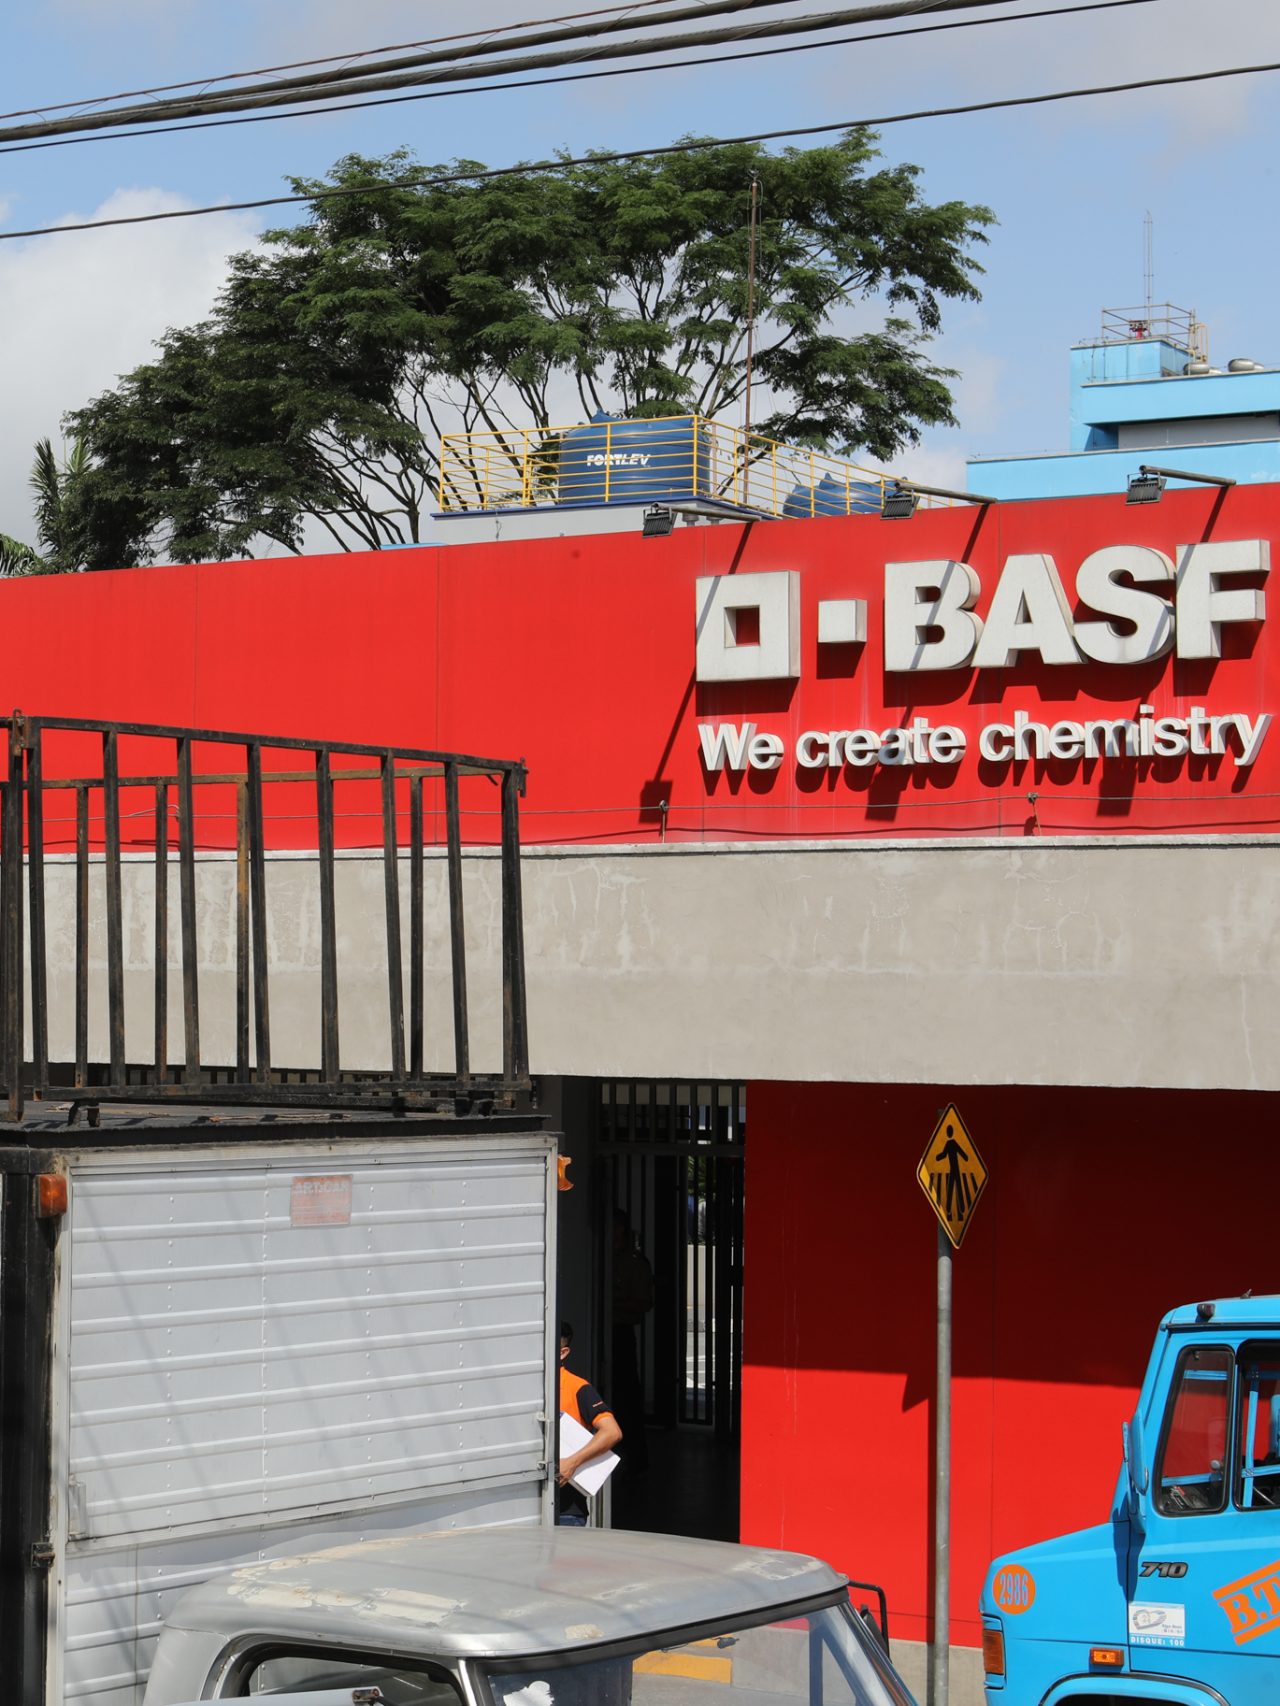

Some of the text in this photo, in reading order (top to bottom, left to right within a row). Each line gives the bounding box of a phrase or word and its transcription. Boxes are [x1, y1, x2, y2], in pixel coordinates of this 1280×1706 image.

[586, 453, 651, 467] FORTLEV
[884, 539, 1271, 672] BASF
[698, 703, 1272, 772] We create chemistry
[1139, 1561, 1189, 1579] 710
[999, 1573, 1029, 1607] 2986
